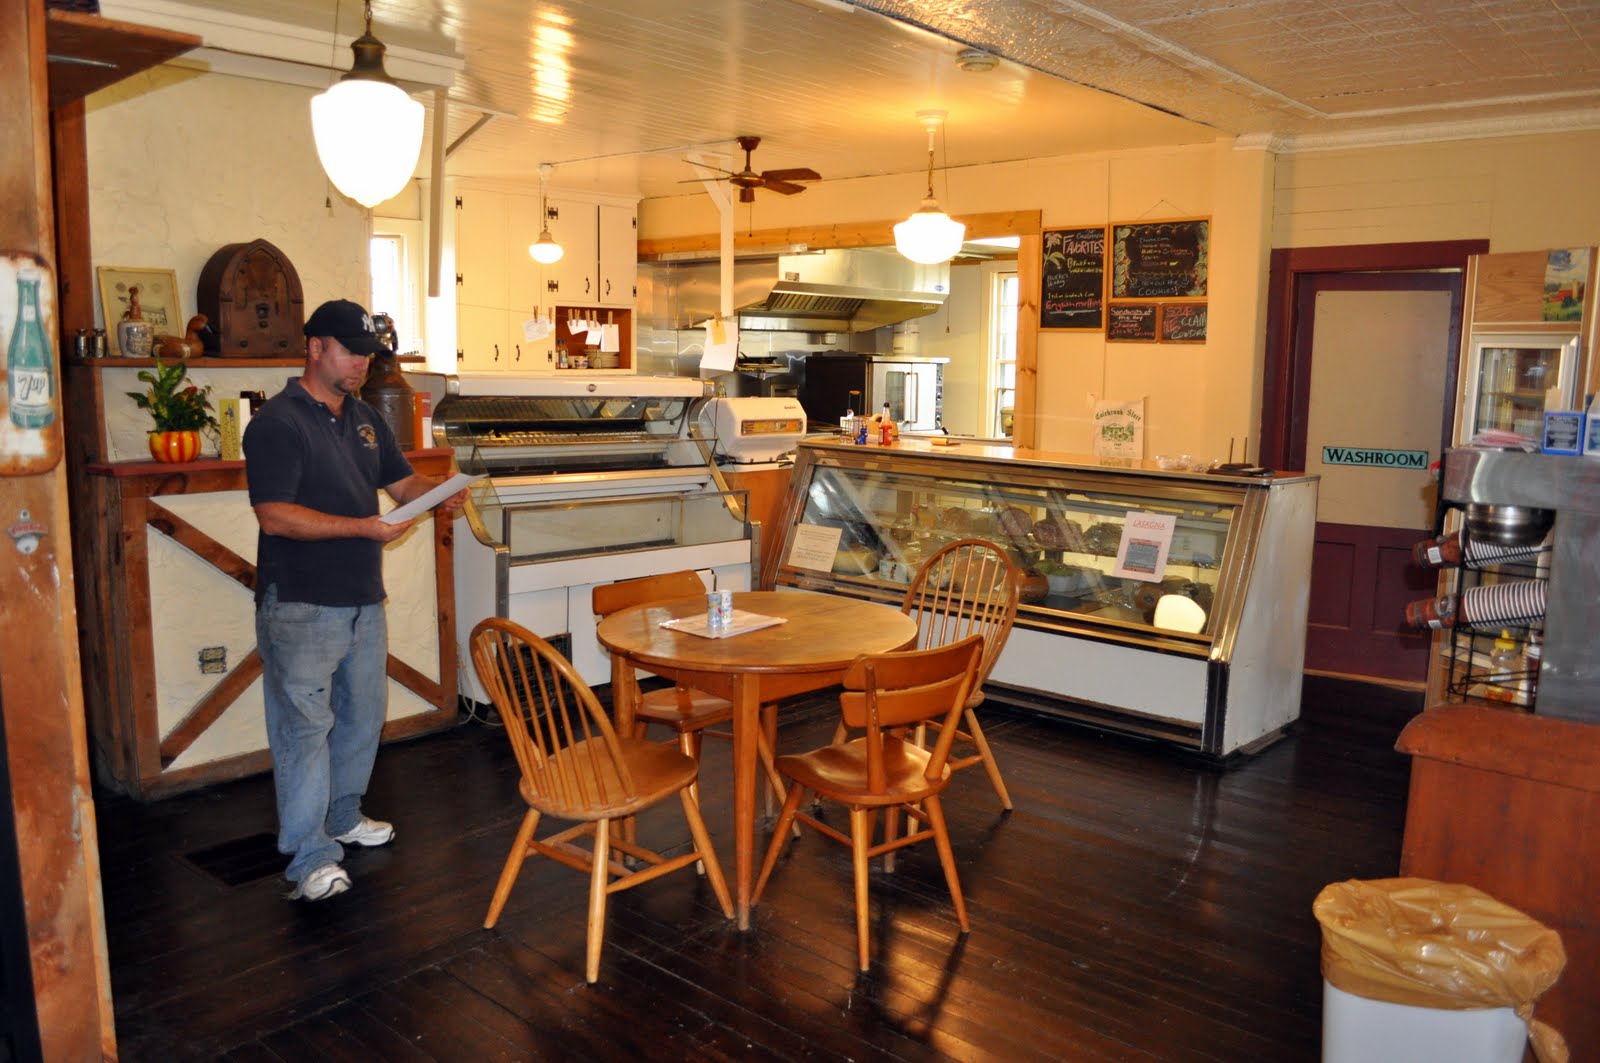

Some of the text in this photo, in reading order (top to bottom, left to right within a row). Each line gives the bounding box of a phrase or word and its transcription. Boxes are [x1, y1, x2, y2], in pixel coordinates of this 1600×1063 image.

[1063, 235, 1104, 255] FAVORITES
[1181, 312, 1206, 328] CLAM
[1326, 448, 1424, 466] WASHROOM
[1133, 519, 1166, 529] LASAGNA
